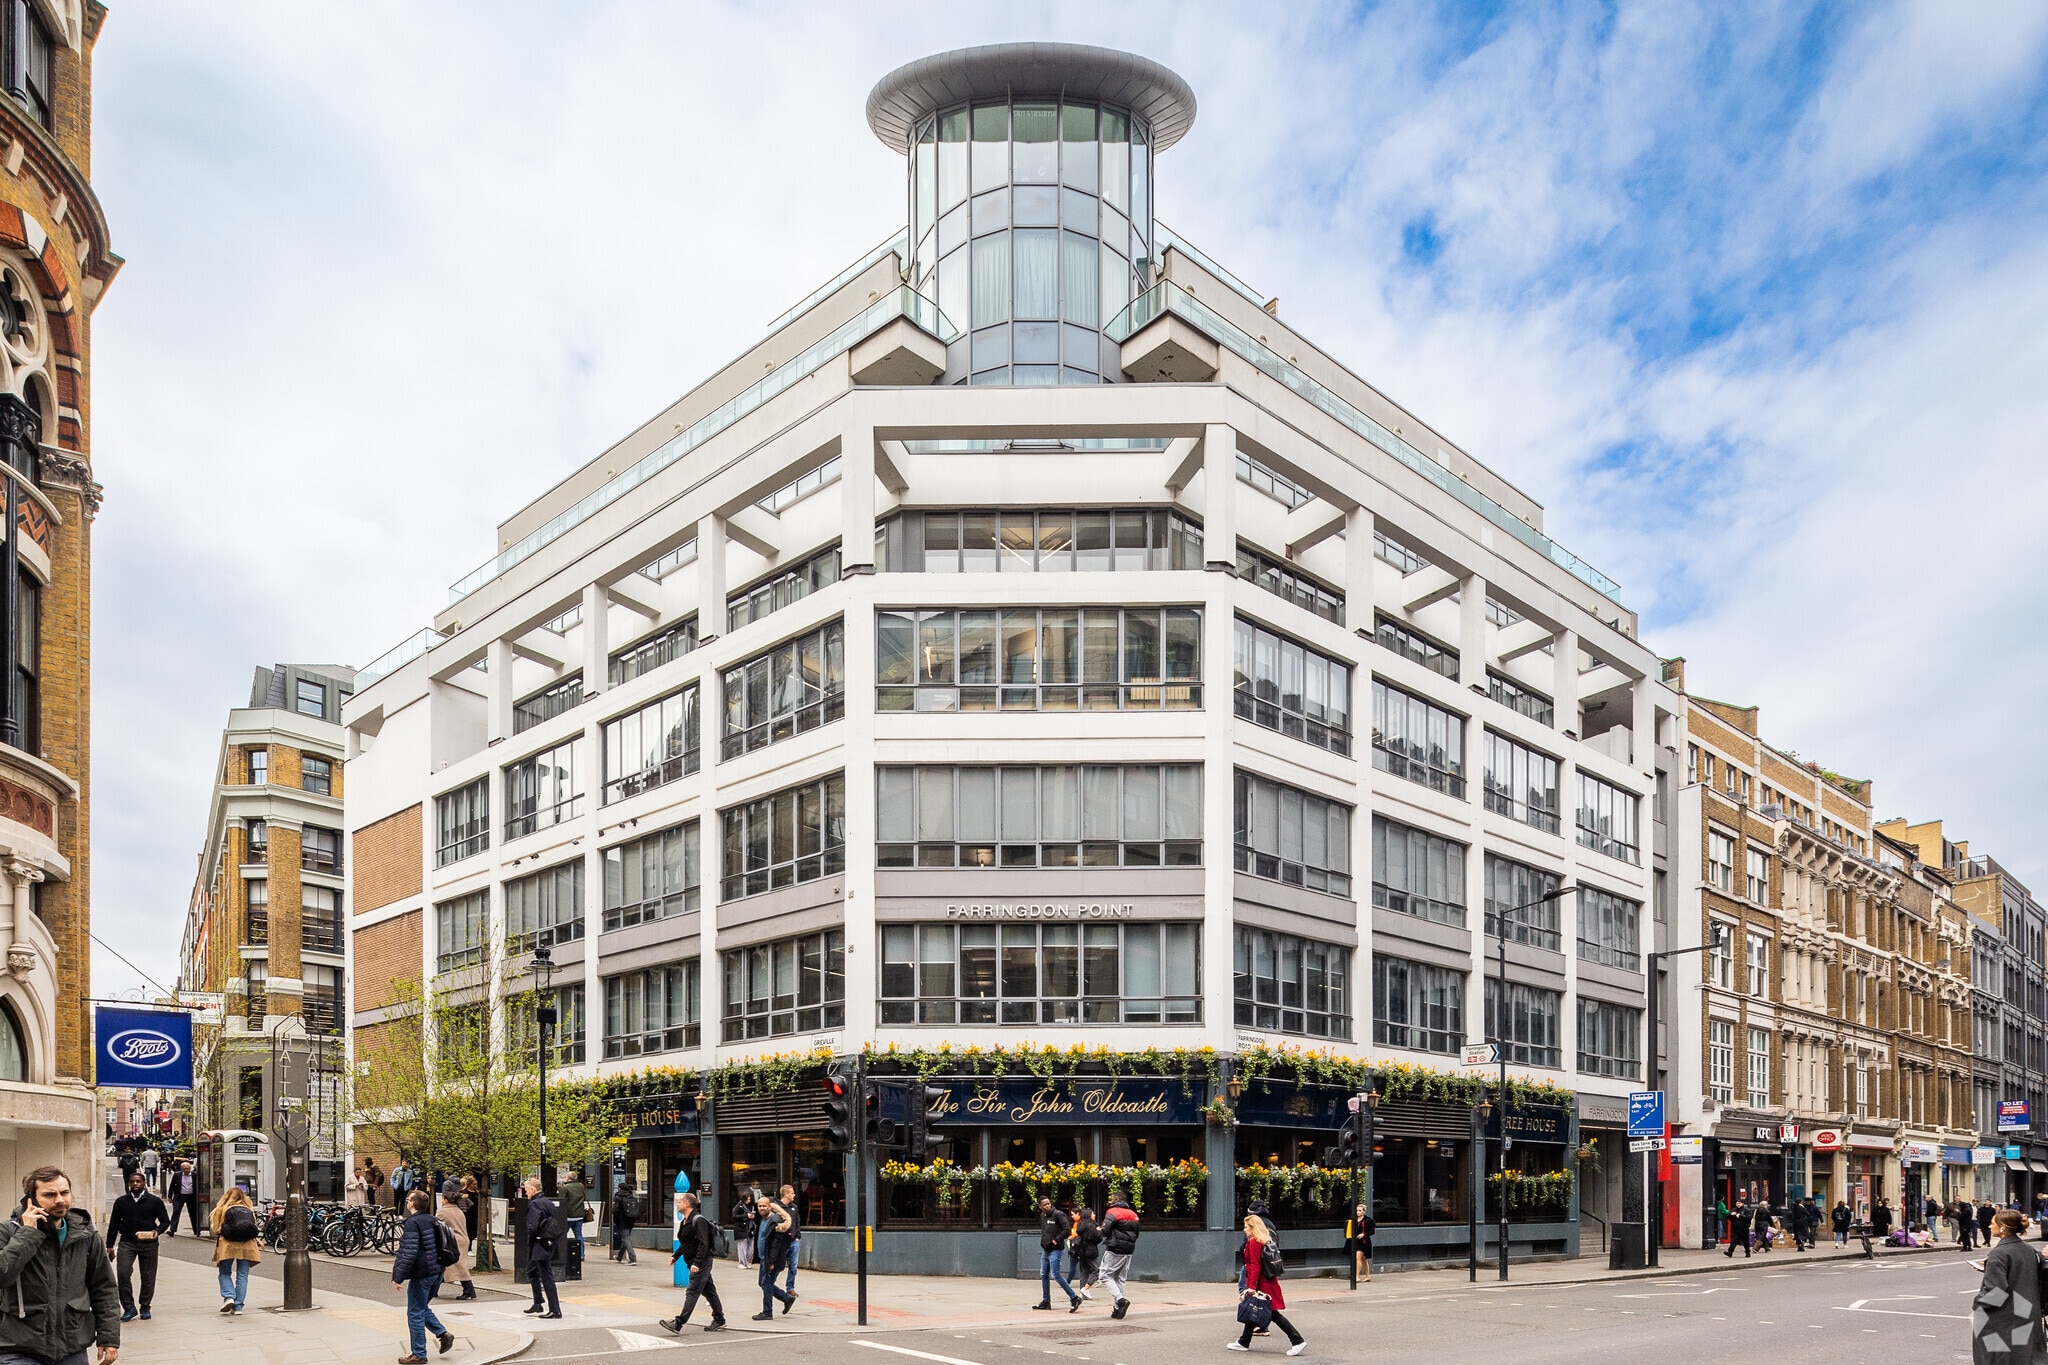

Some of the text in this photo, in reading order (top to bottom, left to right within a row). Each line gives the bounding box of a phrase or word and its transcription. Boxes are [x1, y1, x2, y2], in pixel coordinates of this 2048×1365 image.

[946, 903, 1134, 918] FARRINGDON POINT
[120, 1037, 169, 1060] Boots
[813, 1037, 835, 1046] GREVILLE
[928, 1088, 1168, 1122] The Sir John Oldcastle
[641, 1109, 681, 1126] HOUSE
[1588, 1107, 1628, 1120] FARRINGDON
[1505, 1116, 1556, 1132] REE HOUSE
[1756, 1126, 1771, 1139] KFC
